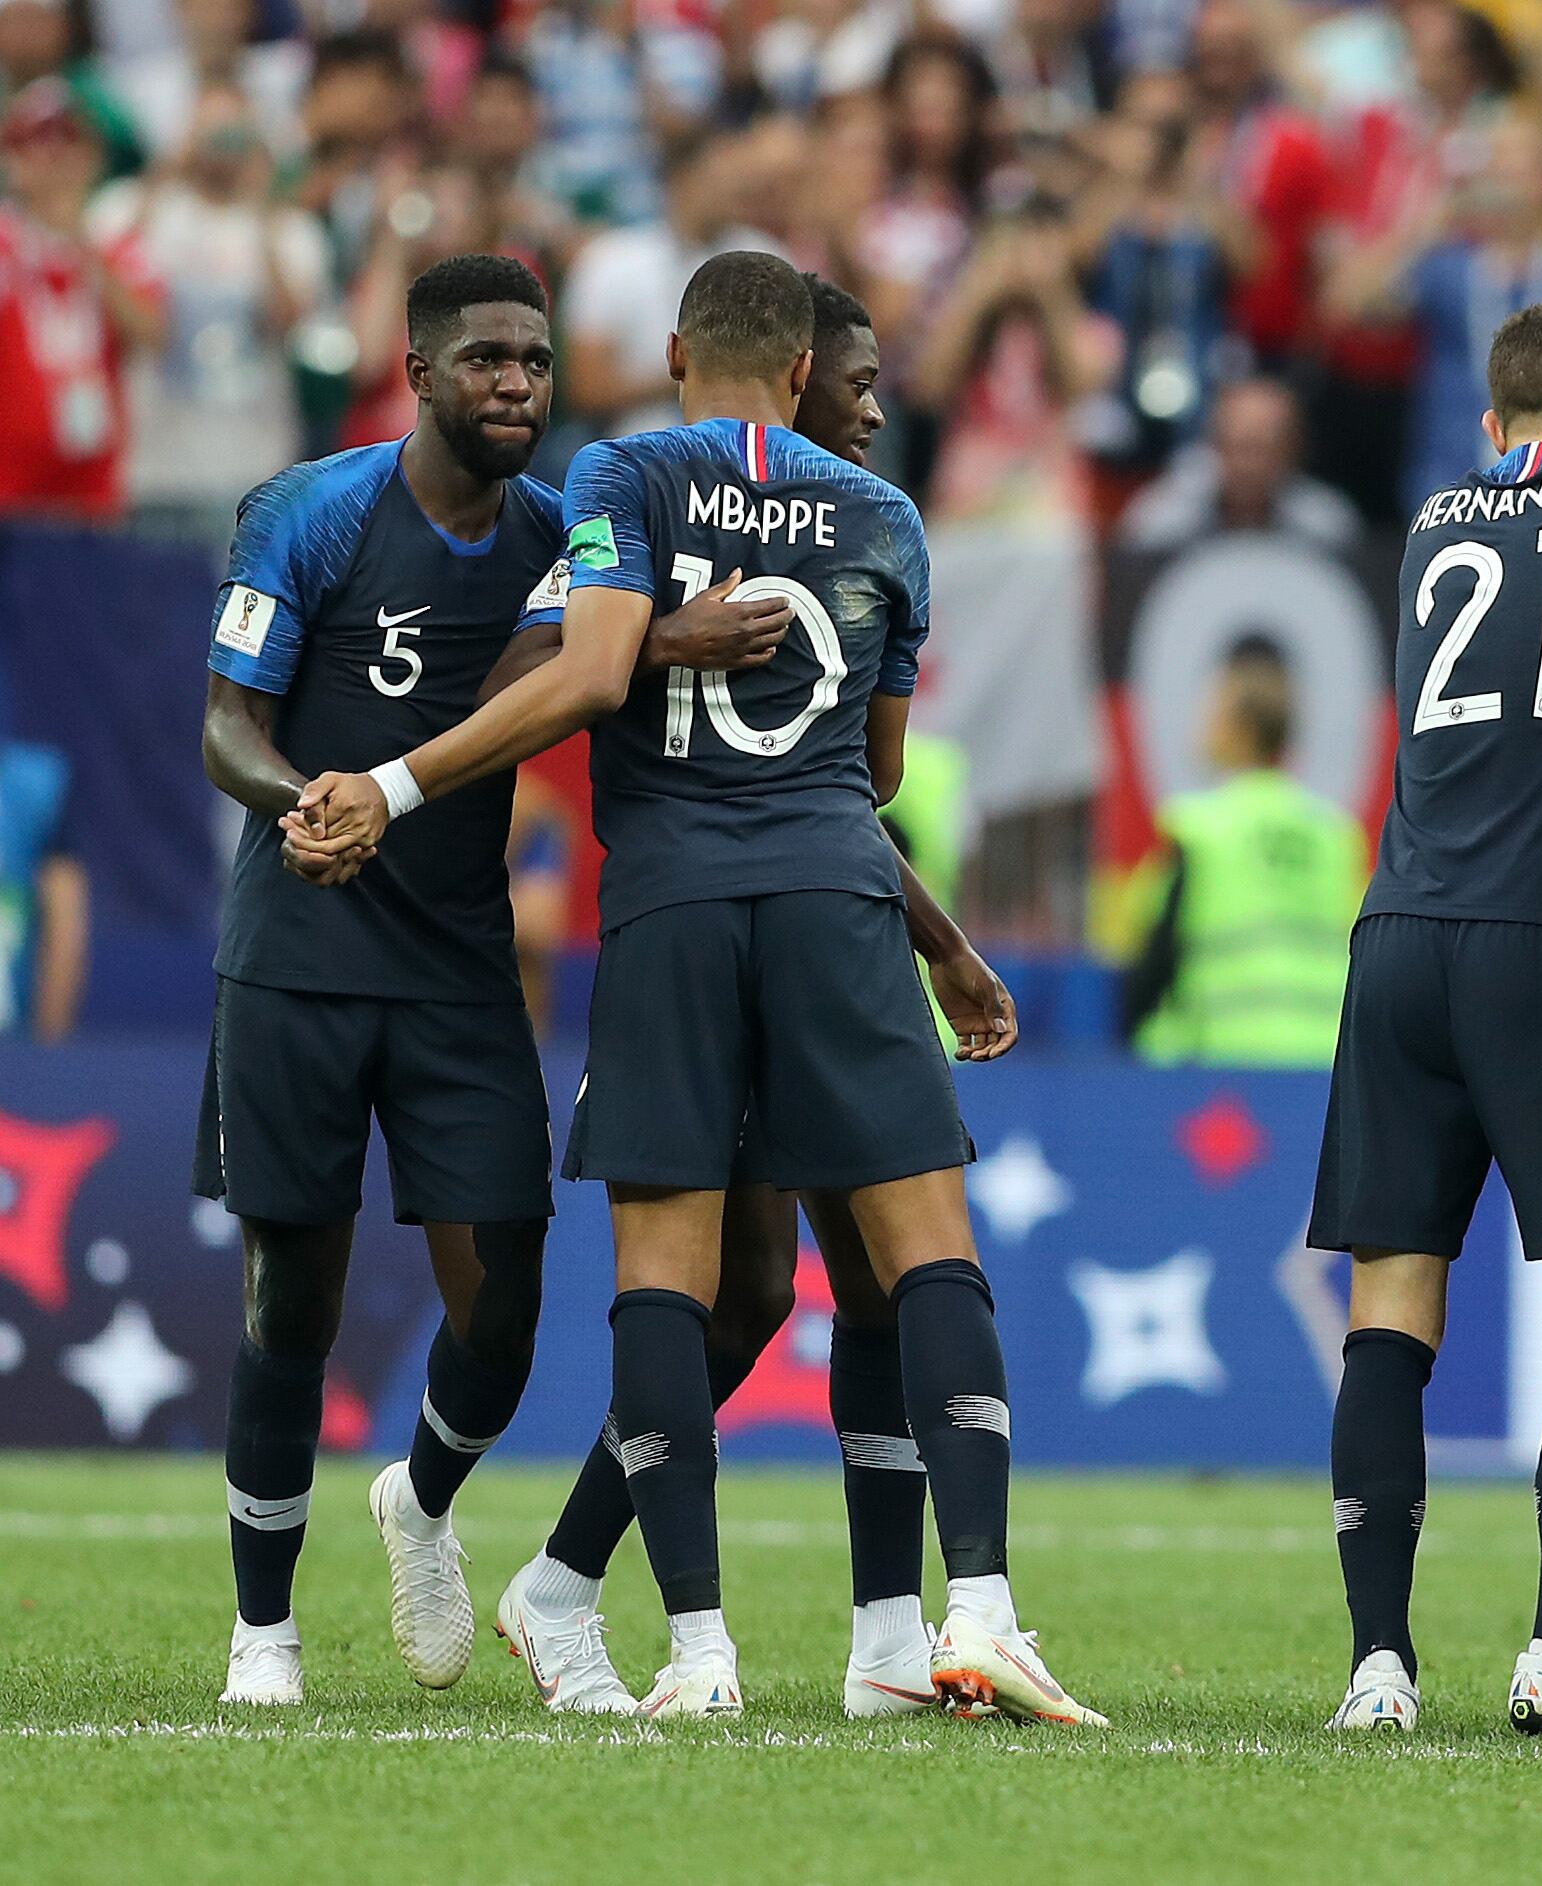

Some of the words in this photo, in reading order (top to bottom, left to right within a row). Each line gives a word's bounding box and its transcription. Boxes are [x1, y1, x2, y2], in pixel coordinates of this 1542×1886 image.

[687, 480, 837, 548] MBAPPE
[368, 627, 422, 697] 5
[664, 552, 848, 757] 10
